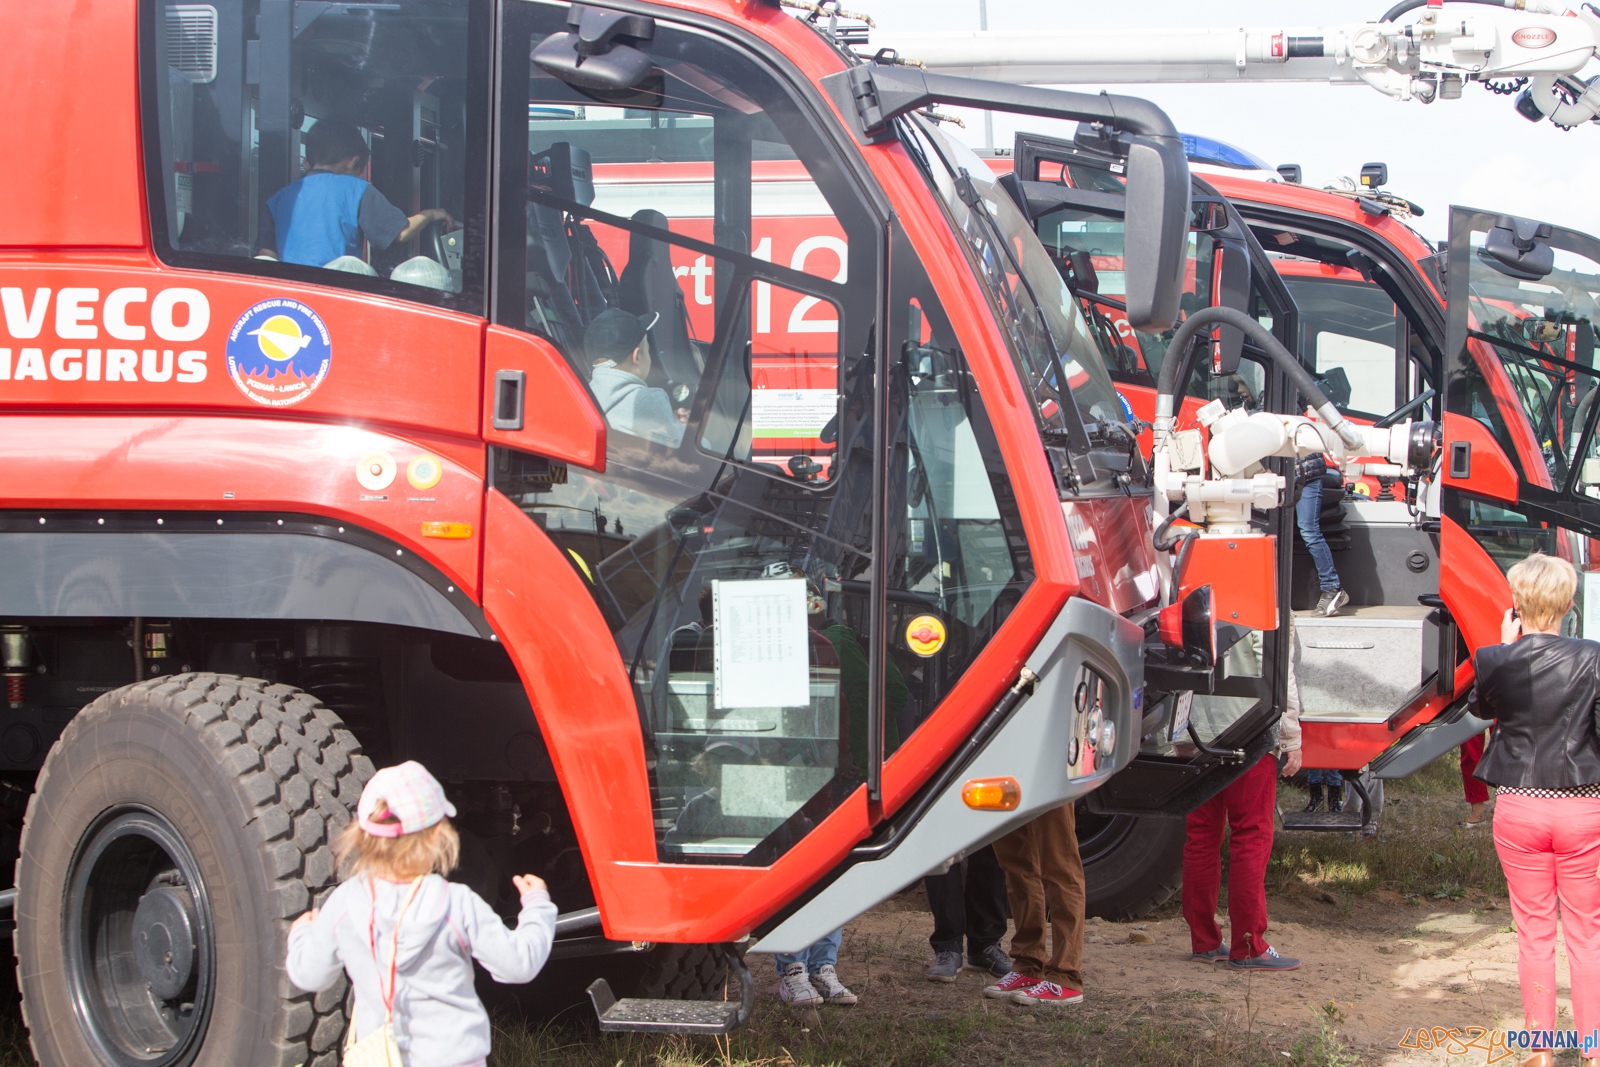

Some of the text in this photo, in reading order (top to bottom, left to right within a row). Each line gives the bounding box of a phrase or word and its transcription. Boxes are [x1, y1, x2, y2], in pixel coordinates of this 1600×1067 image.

[230, 300, 330, 346] AIRCRAFT RESCUE AND FIRE FIGHTING
[246, 378, 275, 392] POZNAŃ
[1119, 395, 1133, 415] FIGHTING
